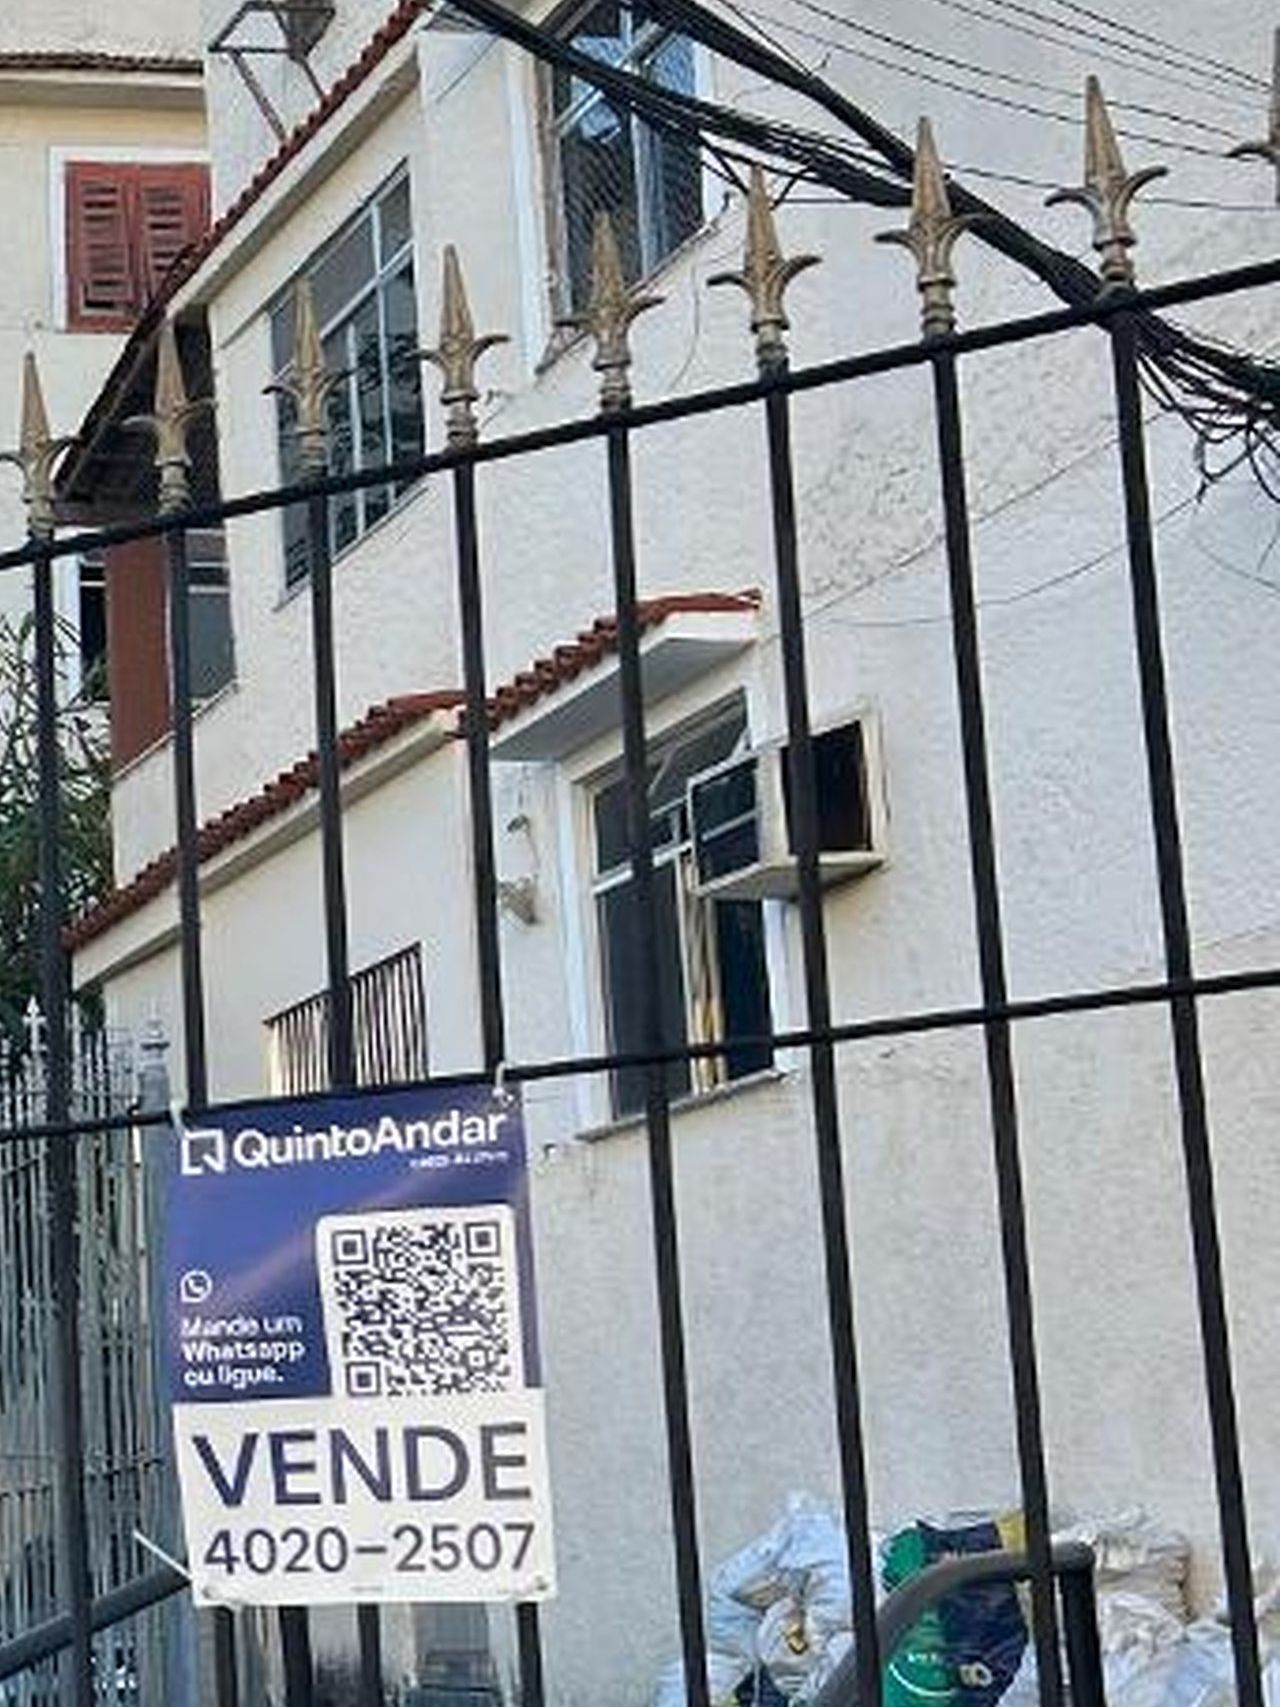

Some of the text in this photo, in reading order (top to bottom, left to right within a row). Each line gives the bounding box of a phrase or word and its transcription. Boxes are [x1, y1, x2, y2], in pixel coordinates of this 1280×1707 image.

[233, 1110, 507, 1167] QuintoAndar
[181, 1314, 303, 1336] Mande um
[181, 1340, 306, 1363] Whatsapp
[183, 1365, 285, 1390] ou ligue.
[191, 1422, 532, 1508] VENDE
[203, 1523, 536, 1576] 4020-2507
